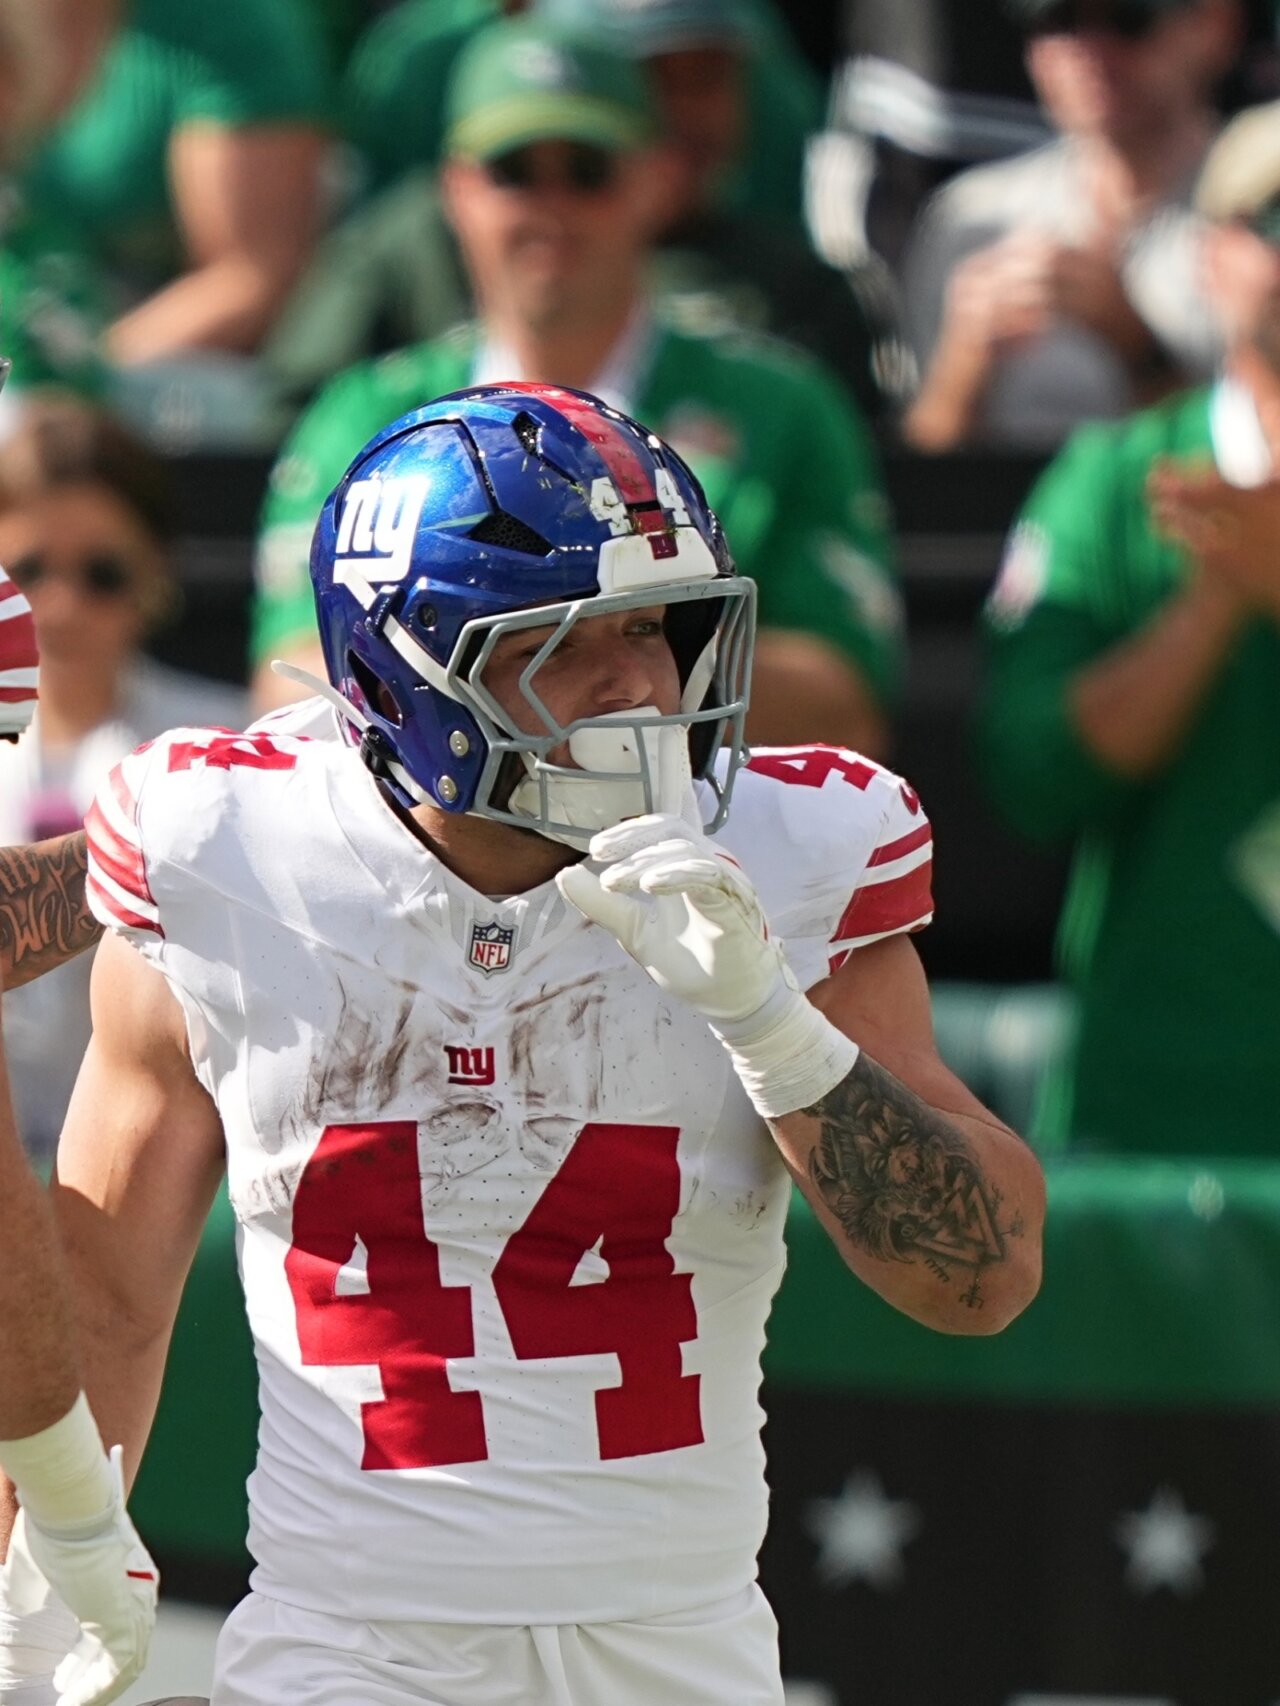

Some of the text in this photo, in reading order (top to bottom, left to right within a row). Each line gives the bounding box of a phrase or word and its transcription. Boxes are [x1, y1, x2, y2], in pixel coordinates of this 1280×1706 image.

[589, 467, 692, 537] 44
[473, 941, 507, 968] NFL
[443, 1044, 496, 1087] ny
[284, 1120, 705, 1471] 44
